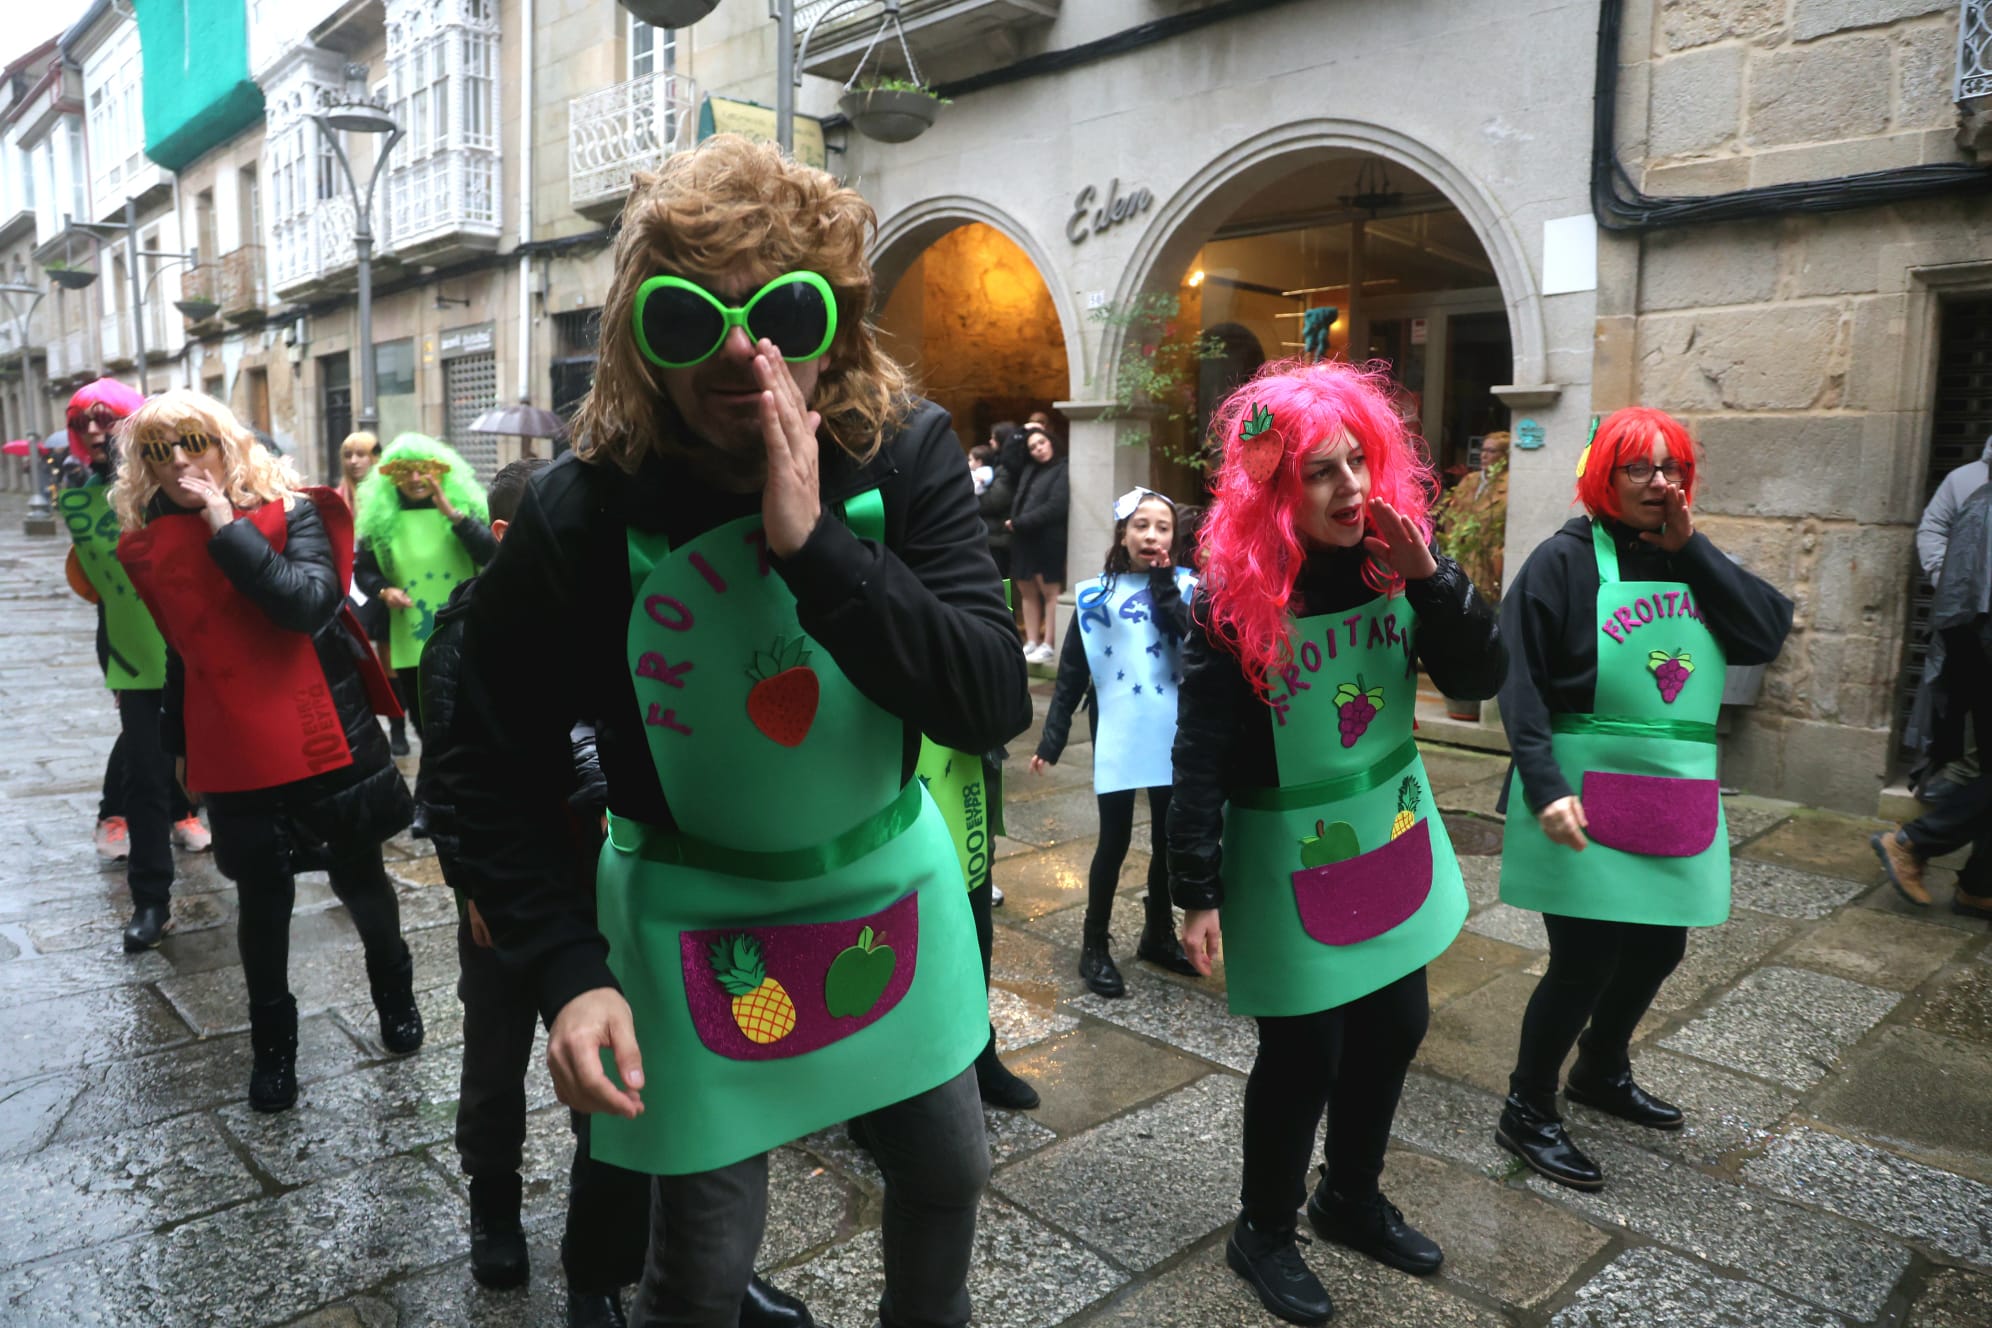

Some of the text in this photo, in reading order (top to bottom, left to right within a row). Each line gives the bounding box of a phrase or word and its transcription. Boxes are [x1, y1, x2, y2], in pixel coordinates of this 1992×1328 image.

[1066, 177, 1155, 247] Eden
[60, 490, 93, 547] 100
[634, 528, 771, 737] FROIT
[1078, 586, 1112, 635] 20
[1601, 591, 1712, 644] FROITA
[301, 733, 348, 773] 10
[966, 830, 986, 891] 100
